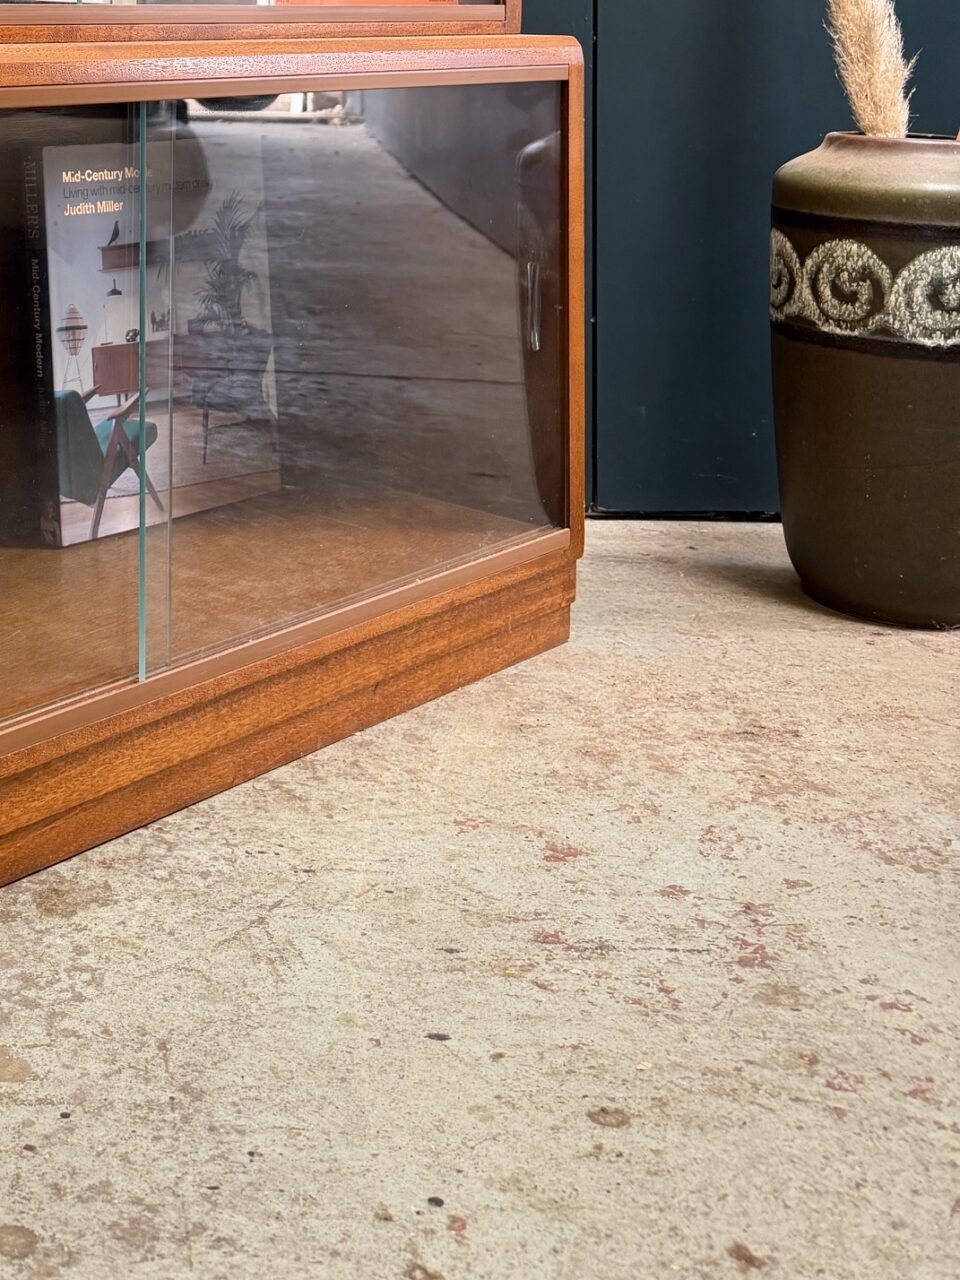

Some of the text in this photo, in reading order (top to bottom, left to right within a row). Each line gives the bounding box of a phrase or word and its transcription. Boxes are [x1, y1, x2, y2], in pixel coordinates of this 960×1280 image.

[62, 170, 123, 182] Mid-Century
[63, 184, 89, 198] Living
[88, 185, 108, 196] with
[64, 200, 123, 216] Judith Miller
[31, 258, 43, 377] Mid-Century Modern
